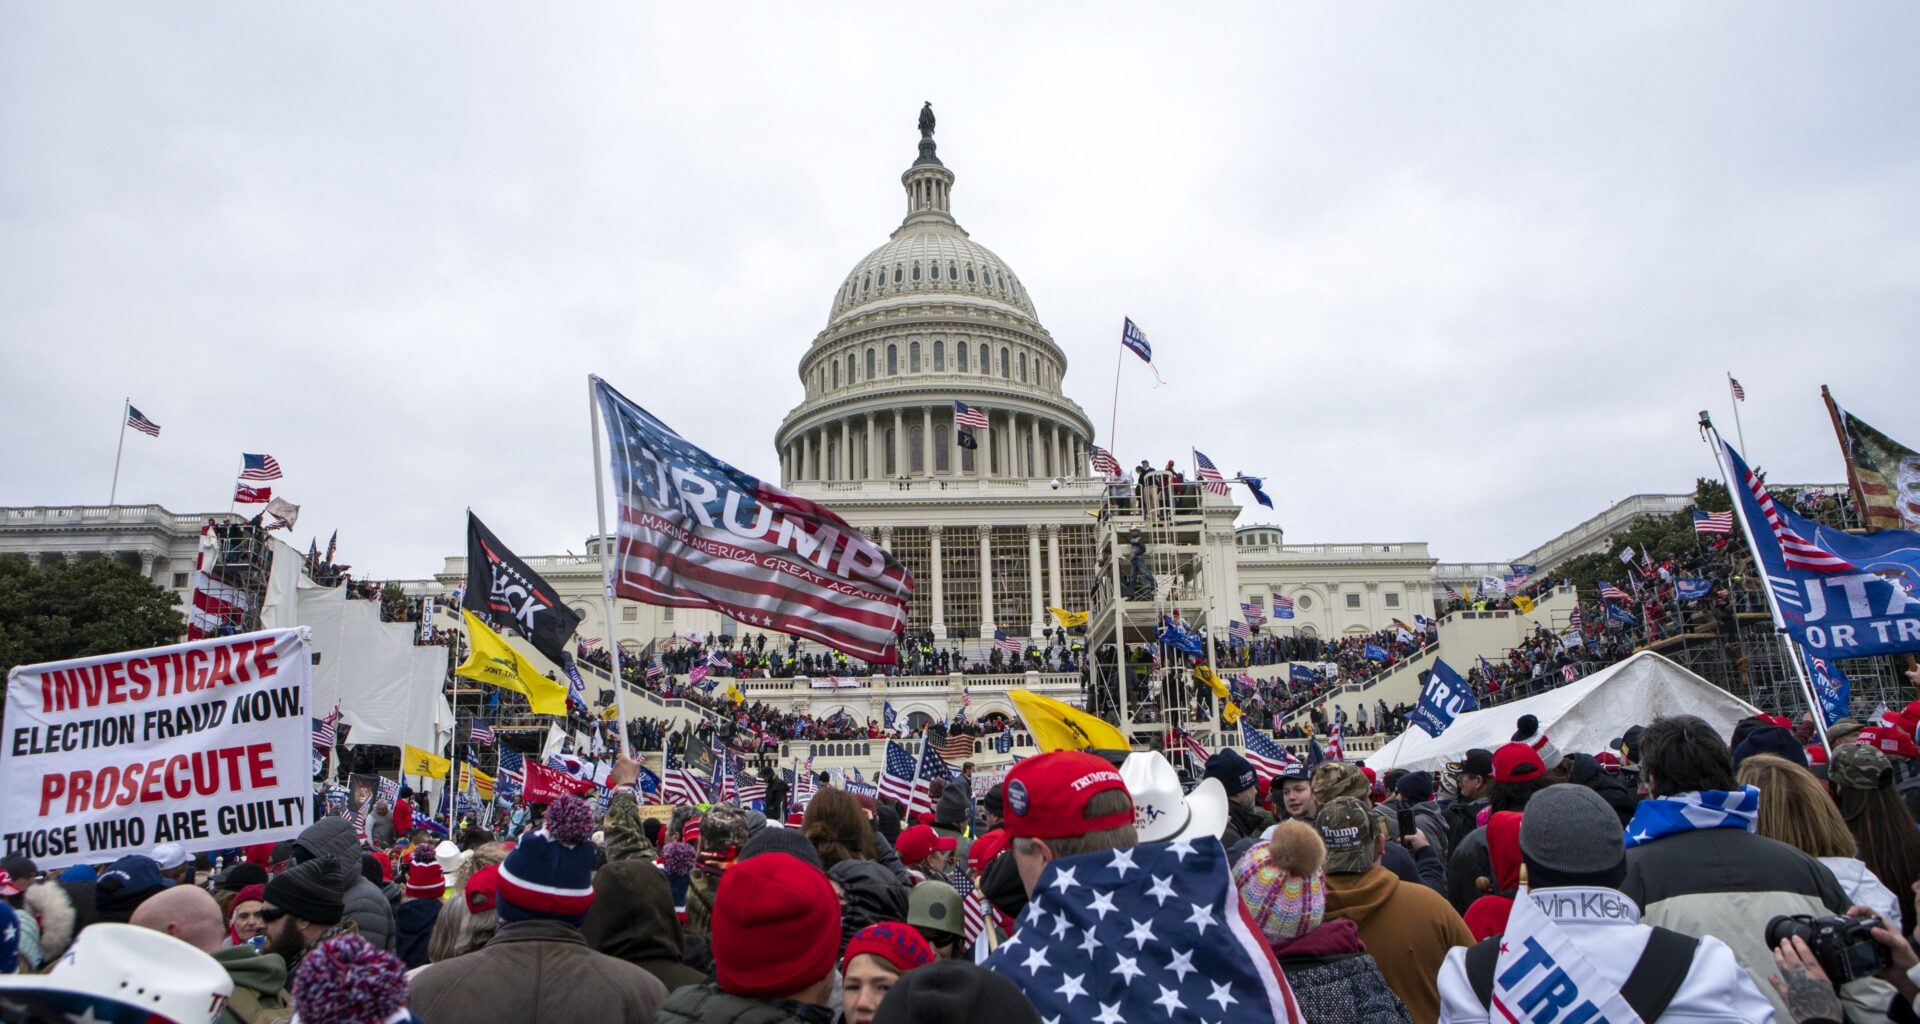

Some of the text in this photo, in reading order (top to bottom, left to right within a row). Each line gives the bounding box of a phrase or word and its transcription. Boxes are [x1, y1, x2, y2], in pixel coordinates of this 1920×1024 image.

[640, 447, 886, 579] TRUMP
[641, 513, 888, 602] MAKING AMERICA GREAT AGAIN!
[422, 598, 433, 640] TRUMP
[1805, 625, 1859, 649] OR
[40, 636, 279, 714] INVESTIGATE
[569, 664, 585, 690] TRUMP
[12, 685, 304, 757] ELECTION FRAUD NOW.
[38, 742, 279, 817] PROSECUTE
[846, 783, 877, 798] TRUMP
[3, 795, 305, 860] THOSE WHO ARE GUILTY
[1321, 826, 1359, 838] Trump
[1581, 892, 1630, 920] Klein
